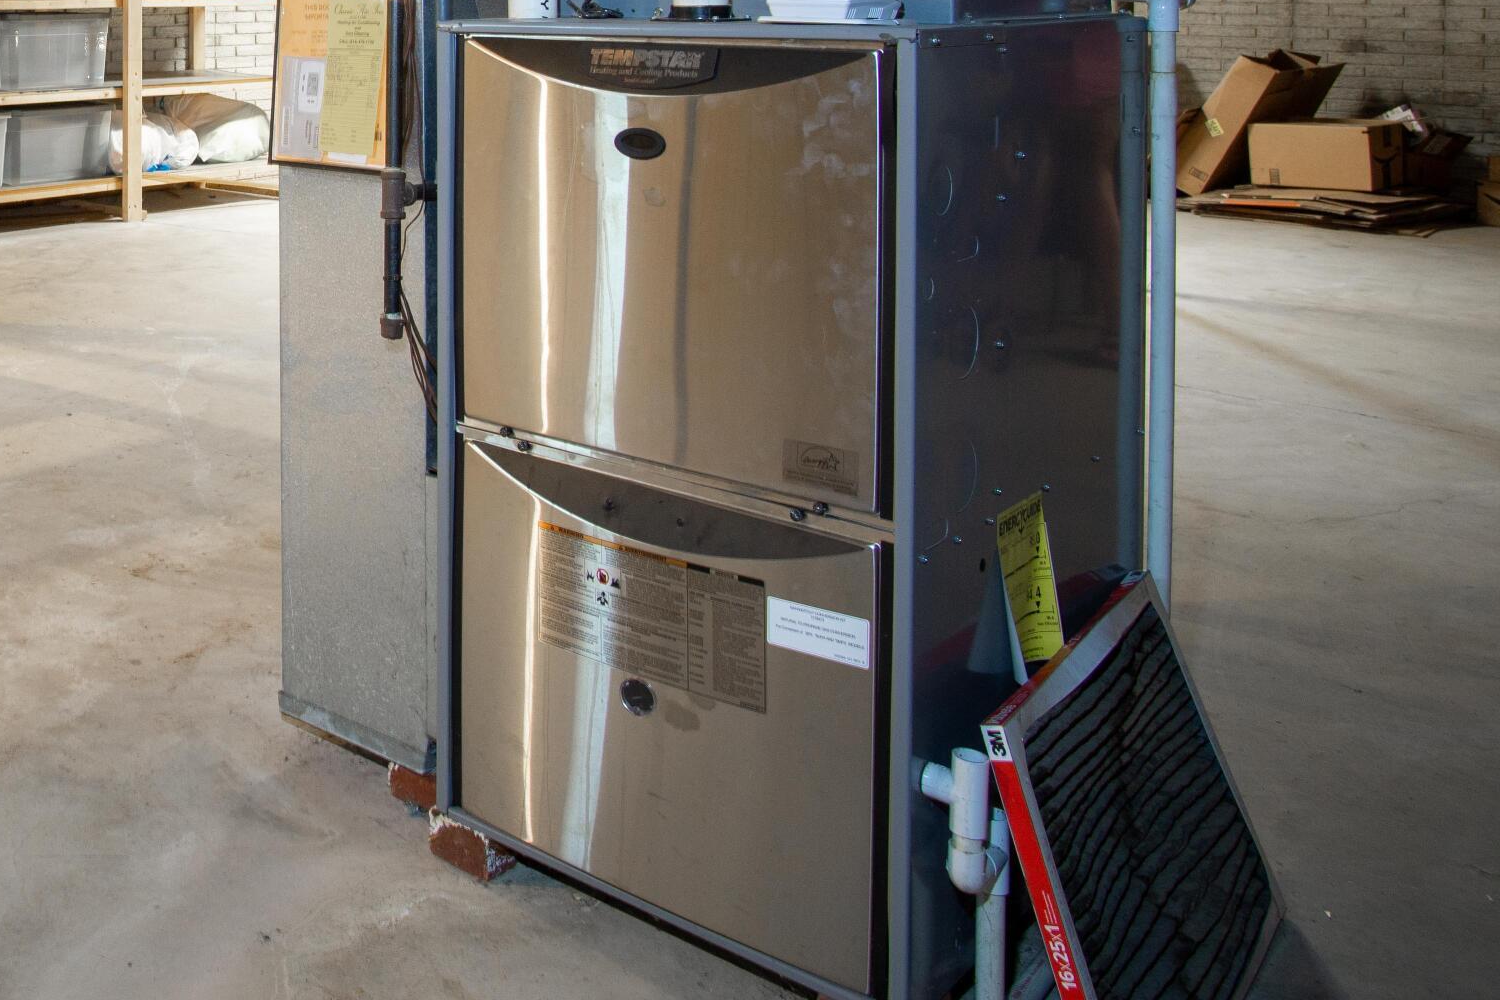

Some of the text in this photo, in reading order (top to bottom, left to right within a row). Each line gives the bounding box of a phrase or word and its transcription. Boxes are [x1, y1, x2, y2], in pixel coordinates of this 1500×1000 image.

[590, 48, 702, 70] TEMPSTAR
[664, 68, 699, 79] Products
[987, 729, 1007, 757] 3M
[1044, 923, 1077, 992] 16x25x1
